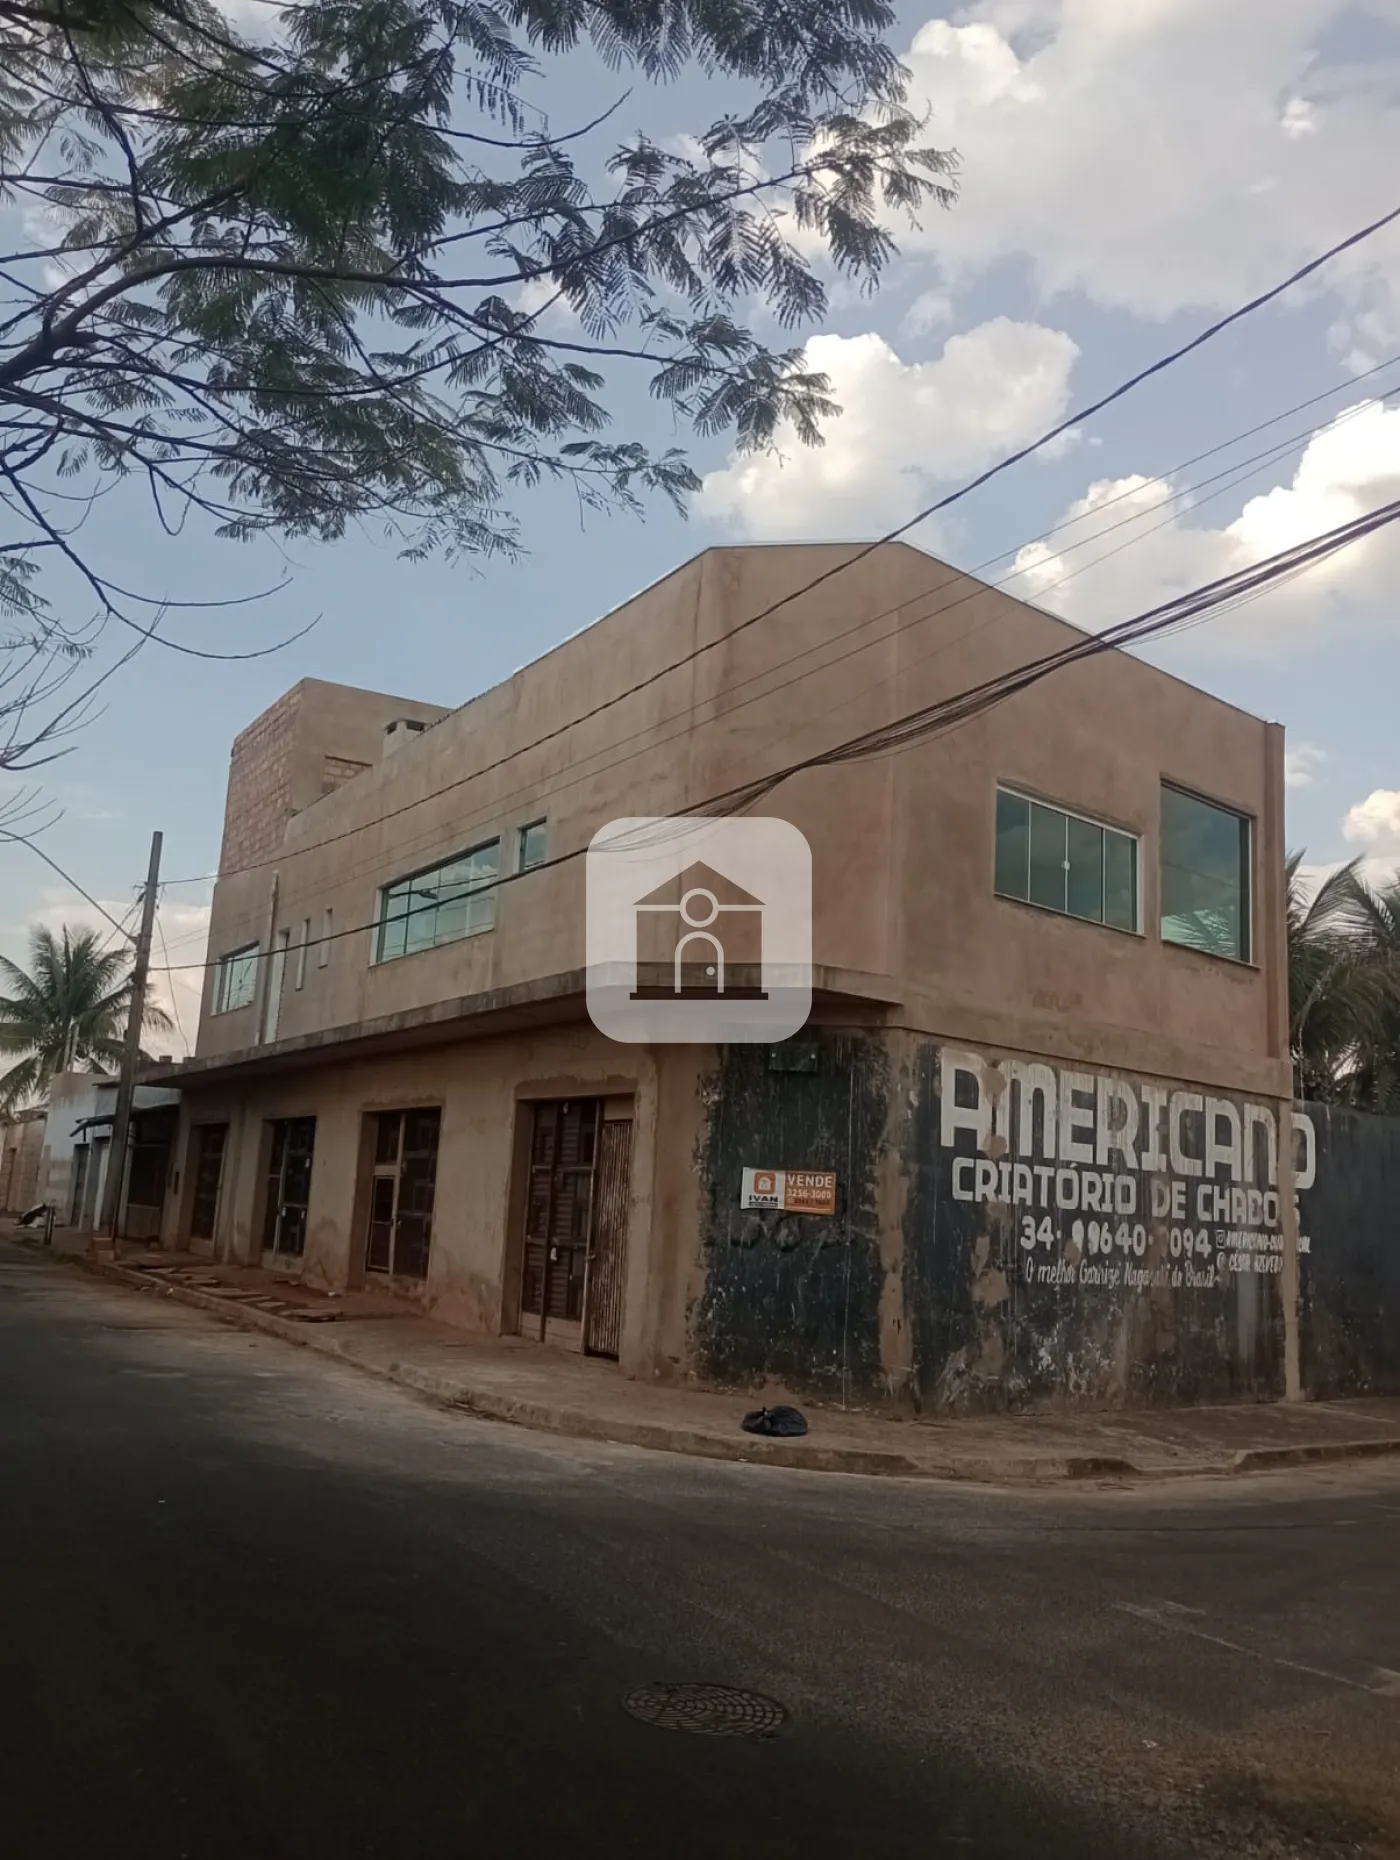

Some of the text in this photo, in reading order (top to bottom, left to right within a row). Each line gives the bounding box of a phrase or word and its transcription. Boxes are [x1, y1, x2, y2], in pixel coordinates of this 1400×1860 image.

[787, 1174, 832, 1188] VENDE
[952, 1157, 1300, 1228] CRIATÓRIO DE CHABO
